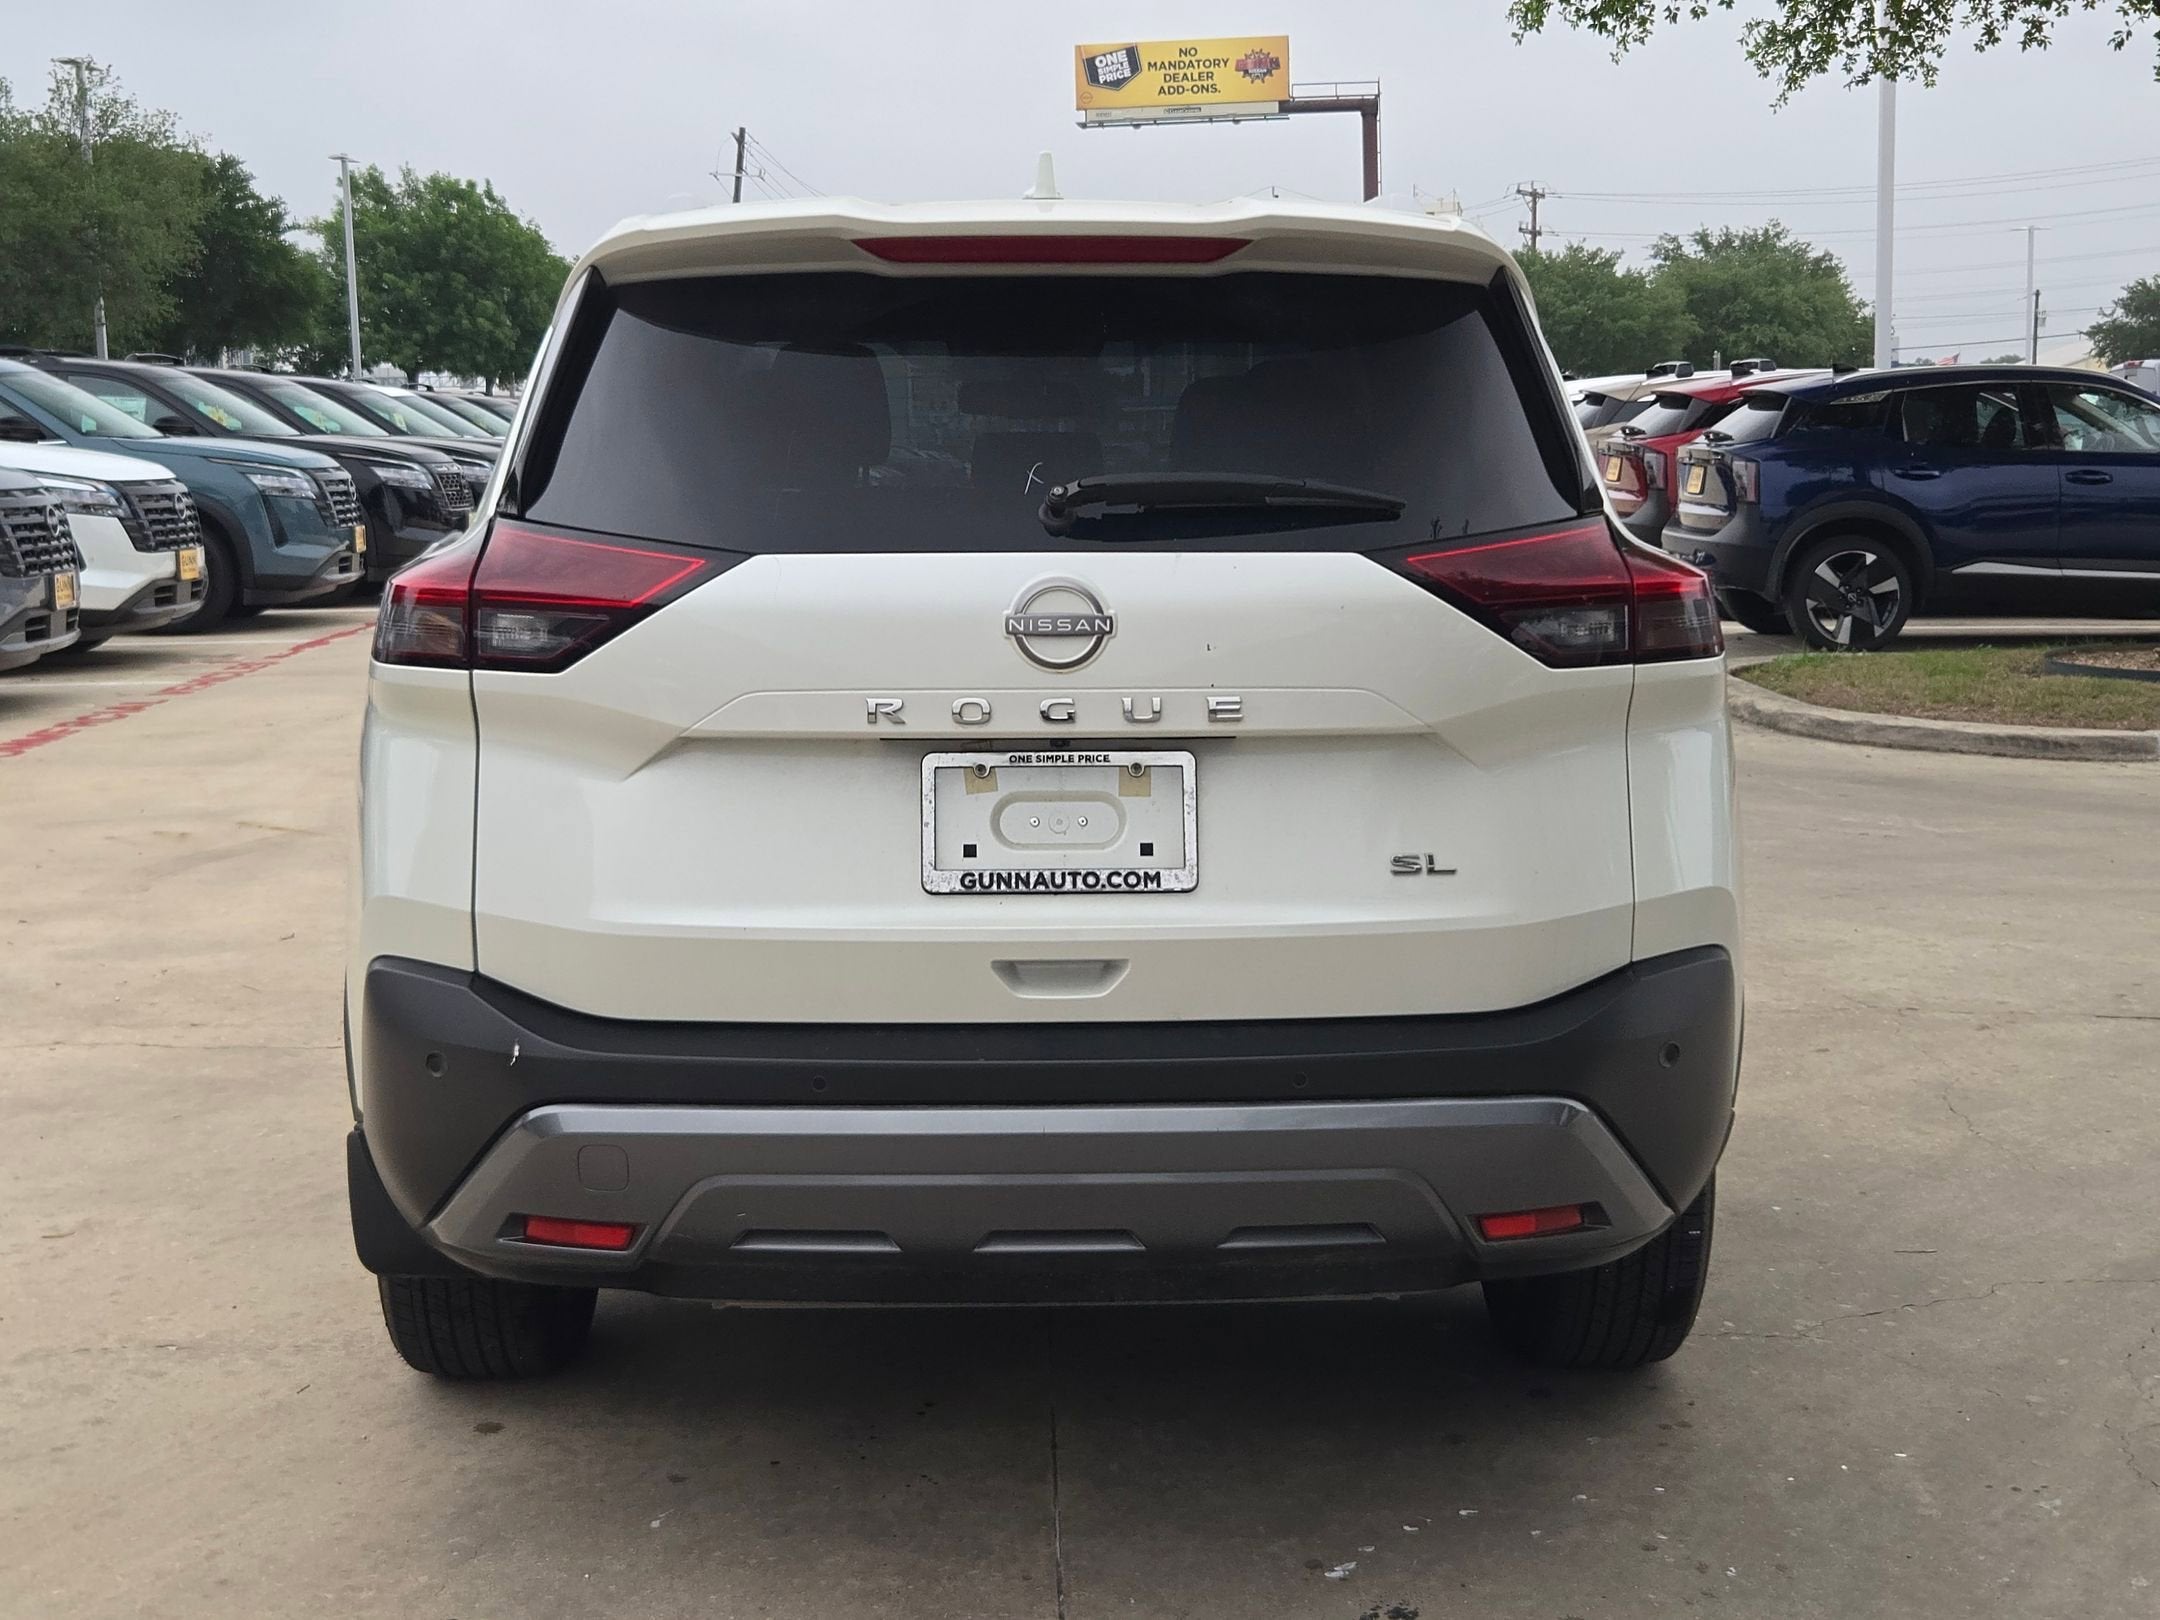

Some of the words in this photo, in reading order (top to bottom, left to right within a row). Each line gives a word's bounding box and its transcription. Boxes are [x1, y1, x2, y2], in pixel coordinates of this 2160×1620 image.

[1095, 50, 1128, 68] ONE
[1178, 47, 1198, 57] NO
[1097, 61, 1130, 75] SIMPLE
[1147, 58, 1230, 72] MANDATORY
[1099, 68, 1131, 84] PRICE
[1163, 71, 1214, 83] DEALER
[1157, 83, 1222, 96] ADD-ONS.
[1008, 618, 1111, 631] NISSAN
[866, 697, 1243, 725] ROGUE
[1009, 754, 1033, 764] ONE
[1035, 754, 1075, 764] SIMPLE
[1077, 754, 1111, 763] PRICE
[1390, 853, 1457, 876] SL
[960, 871, 1162, 890] GUNNAUTO.COM
